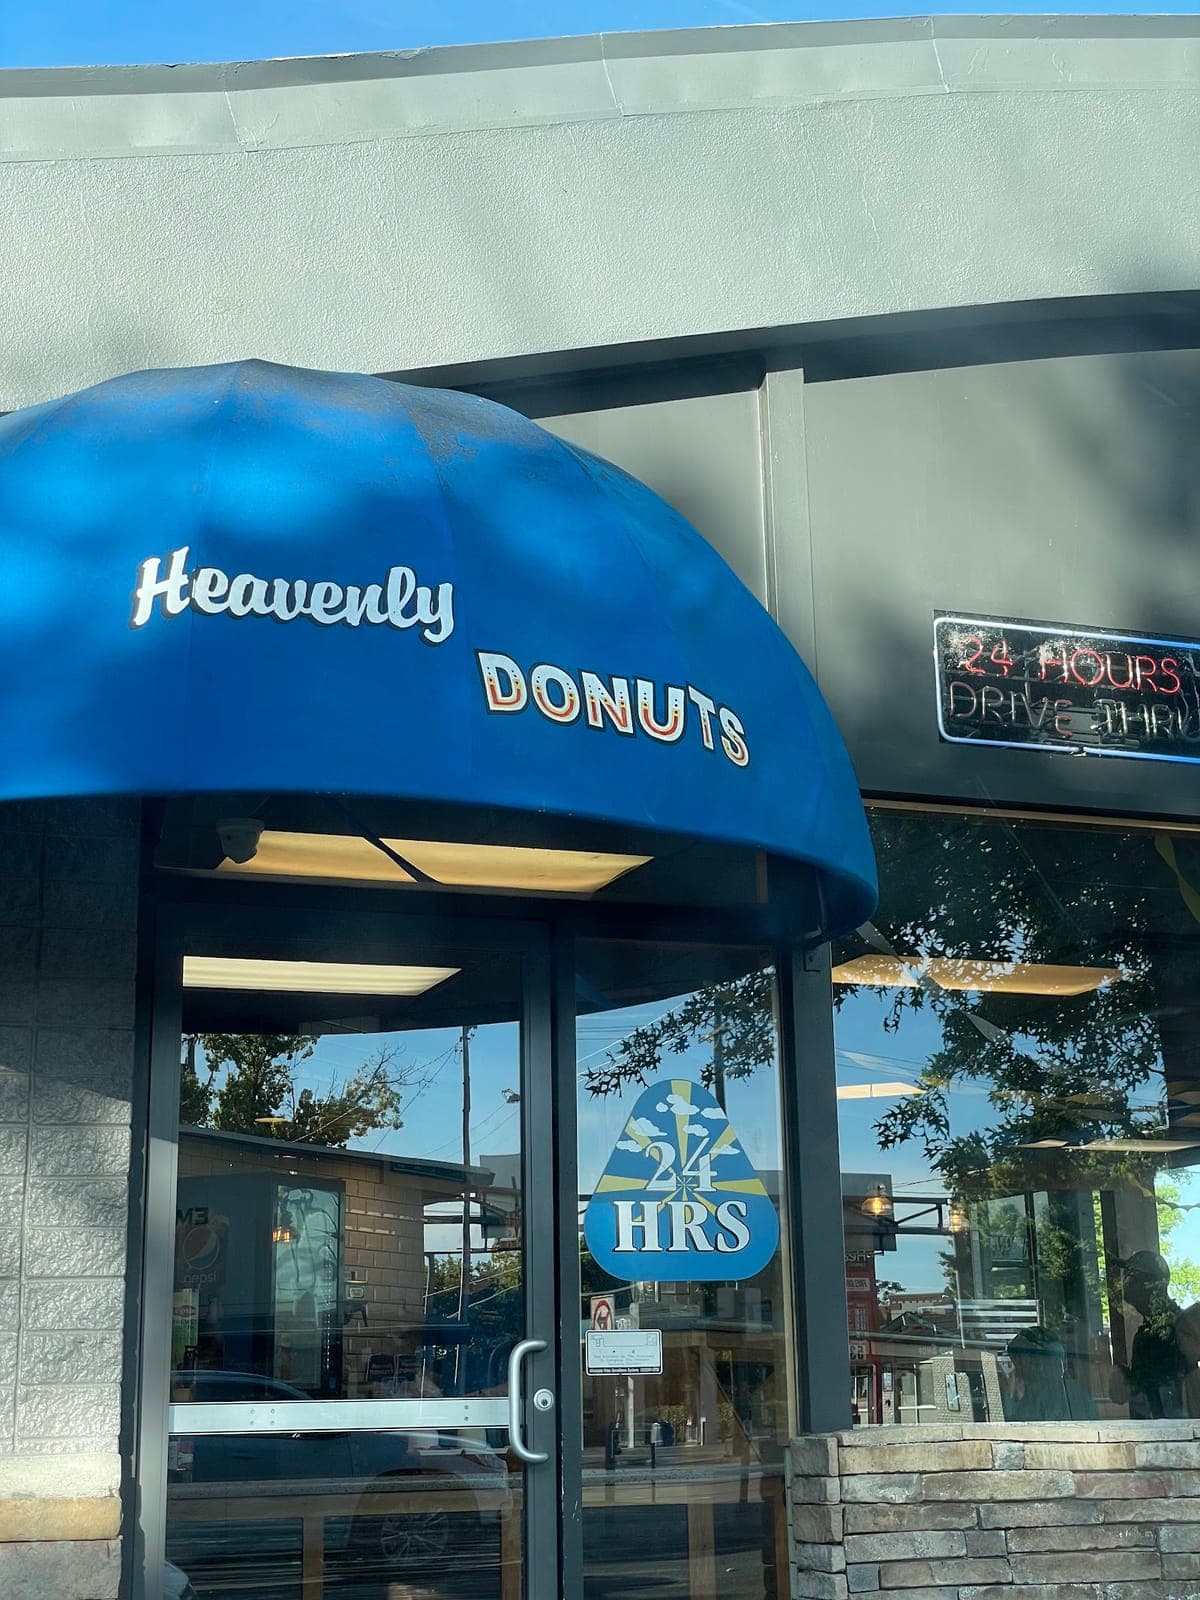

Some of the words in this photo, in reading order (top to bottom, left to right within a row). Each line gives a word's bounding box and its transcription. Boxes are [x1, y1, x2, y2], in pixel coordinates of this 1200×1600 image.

[131, 546, 454, 643] Heavenly
[957, 636, 1014, 677] 24
[1038, 645, 1181, 694] HOURS
[476, 650, 750, 768] DONUTS
[949, 681, 1073, 737] DRIVE
[645, 1137, 718, 1192] 24
[613, 1200, 750, 1252] HRS
